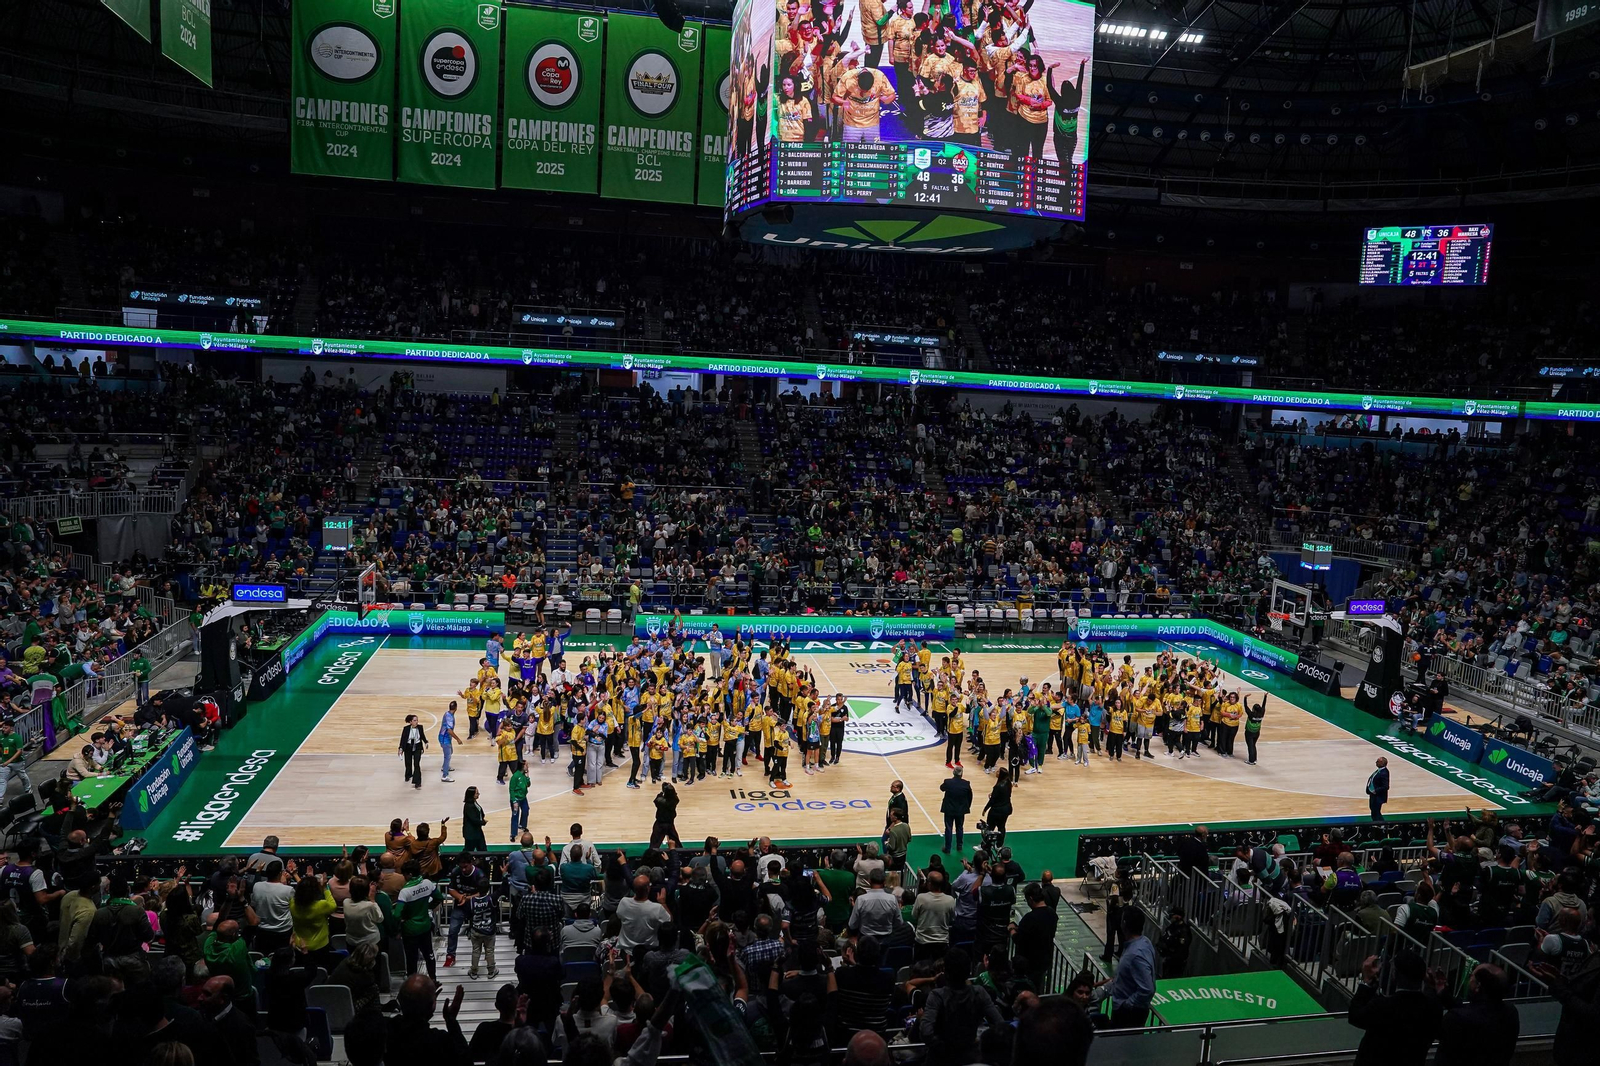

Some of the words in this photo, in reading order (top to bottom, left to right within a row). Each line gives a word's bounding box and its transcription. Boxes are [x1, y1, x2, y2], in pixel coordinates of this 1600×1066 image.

[182, 5, 195, 29] BCL
[1565, 5, 1588, 22] 1999
[180, 24, 196, 50] 2024
[434, 58, 464, 66] supercopa
[541, 70, 560, 78] Copa
[654, 82, 672, 90] FOUR
[296, 96, 388, 126] CAMPEONES
[297, 119, 315, 128] FIBA
[318, 121, 388, 134] INTERCONTINENTAL
[402, 107, 492, 136] CAMPEONES
[335, 129, 349, 137] CUP
[508, 118, 595, 145] CAMPEONES
[402, 129, 492, 149] SUPERCOPA
[607, 125, 692, 152] CAMPEONES
[326, 143, 358, 157] 2024
[508, 139, 539, 153] COPA
[543, 141, 566, 154] DEL
[571, 143, 594, 155] REY
[431, 153, 461, 167] 2024
[637, 154, 661, 166] BCL
[704, 155, 720, 163] FIBA
[938, 158, 947, 166] Q2
[953, 159, 968, 167] BAXI
[536, 162, 565, 176] 2025
[635, 168, 662, 182] 2025
[916, 172, 930, 182] 48
[951, 174, 964, 185] 36
[914, 193, 941, 203] 12:41
[1405, 230, 1416, 238] 48
[1421, 229, 1432, 237] VS
[1437, 229, 1449, 237] 36
[1411, 251, 1437, 260] 12:41
[60, 331, 103, 341] PARTIDO
[105, 333, 153, 344] DEDICADO
[214, 336, 248, 344] Ayuntamiento
[405, 349, 440, 358] PARTIDO
[442, 350, 482, 360] DEDICADO
[534, 352, 564, 360] Ayuntamiento
[634, 357, 664, 365] Ayuntamiento
[709, 363, 741, 372] PARTIDO
[742, 365, 780, 374] DEDICADO
[989, 379, 1018, 388] PARTIDO
[1020, 381, 1054, 390] DEDICADO
[1253, 394, 1284, 403] PARTIDO
[1286, 396, 1323, 405] DEDICADO
[1477, 403, 1510, 411] Ayuntamiento
[1558, 409, 1594, 418] PARTIDO
[325, 521, 346, 529] 12:41
[236, 588, 282, 598] endesa
[316, 602, 348, 612] endesa
[1351, 603, 1383, 611] endesa
[381, 618, 390, 628] A
[426, 617, 472, 626] Ayuntamiento
[474, 617, 483, 625] de
[426, 622, 471, 633] Vélez-Málaga
[886, 623, 928, 631] Ayuntamiento
[1092, 624, 1130, 632] Ayuntamiento
[742, 624, 787, 634] PARTIDO
[790, 624, 844, 634] DEDICADO
[845, 625, 853, 634] A
[885, 629, 925, 637] Vélez-Málaga
[1158, 625, 1196, 635] PARTIDO
[1198, 626, 1229, 643] DEDICADO
[1229, 637, 1234, 646] A
[1253, 643, 1279, 660] Ayuntamiento
[1251, 651, 1276, 667] Vélez-Málaga
[260, 661, 282, 687] endesa
[318, 651, 363, 685] endesa
[1297, 656, 1331, 683] endesa
[1363, 683, 1378, 699] Risi
[1443, 729, 1472, 751] Unicaja
[176, 735, 194, 760] Fundación
[179, 750, 194, 769] Unicaja
[1376, 734, 1530, 804] #ligaendesa
[1506, 757, 1544, 783] Unicaja
[146, 768, 171, 795] Fundación
[149, 782, 169, 805] Unicaja
[172, 749, 277, 843] #ligaendesa
[729, 788, 791, 801] liga
[735, 798, 872, 811] endesa
[473, 911, 491, 925] 55
[1166, 987, 1277, 1010] BALONCESTO
